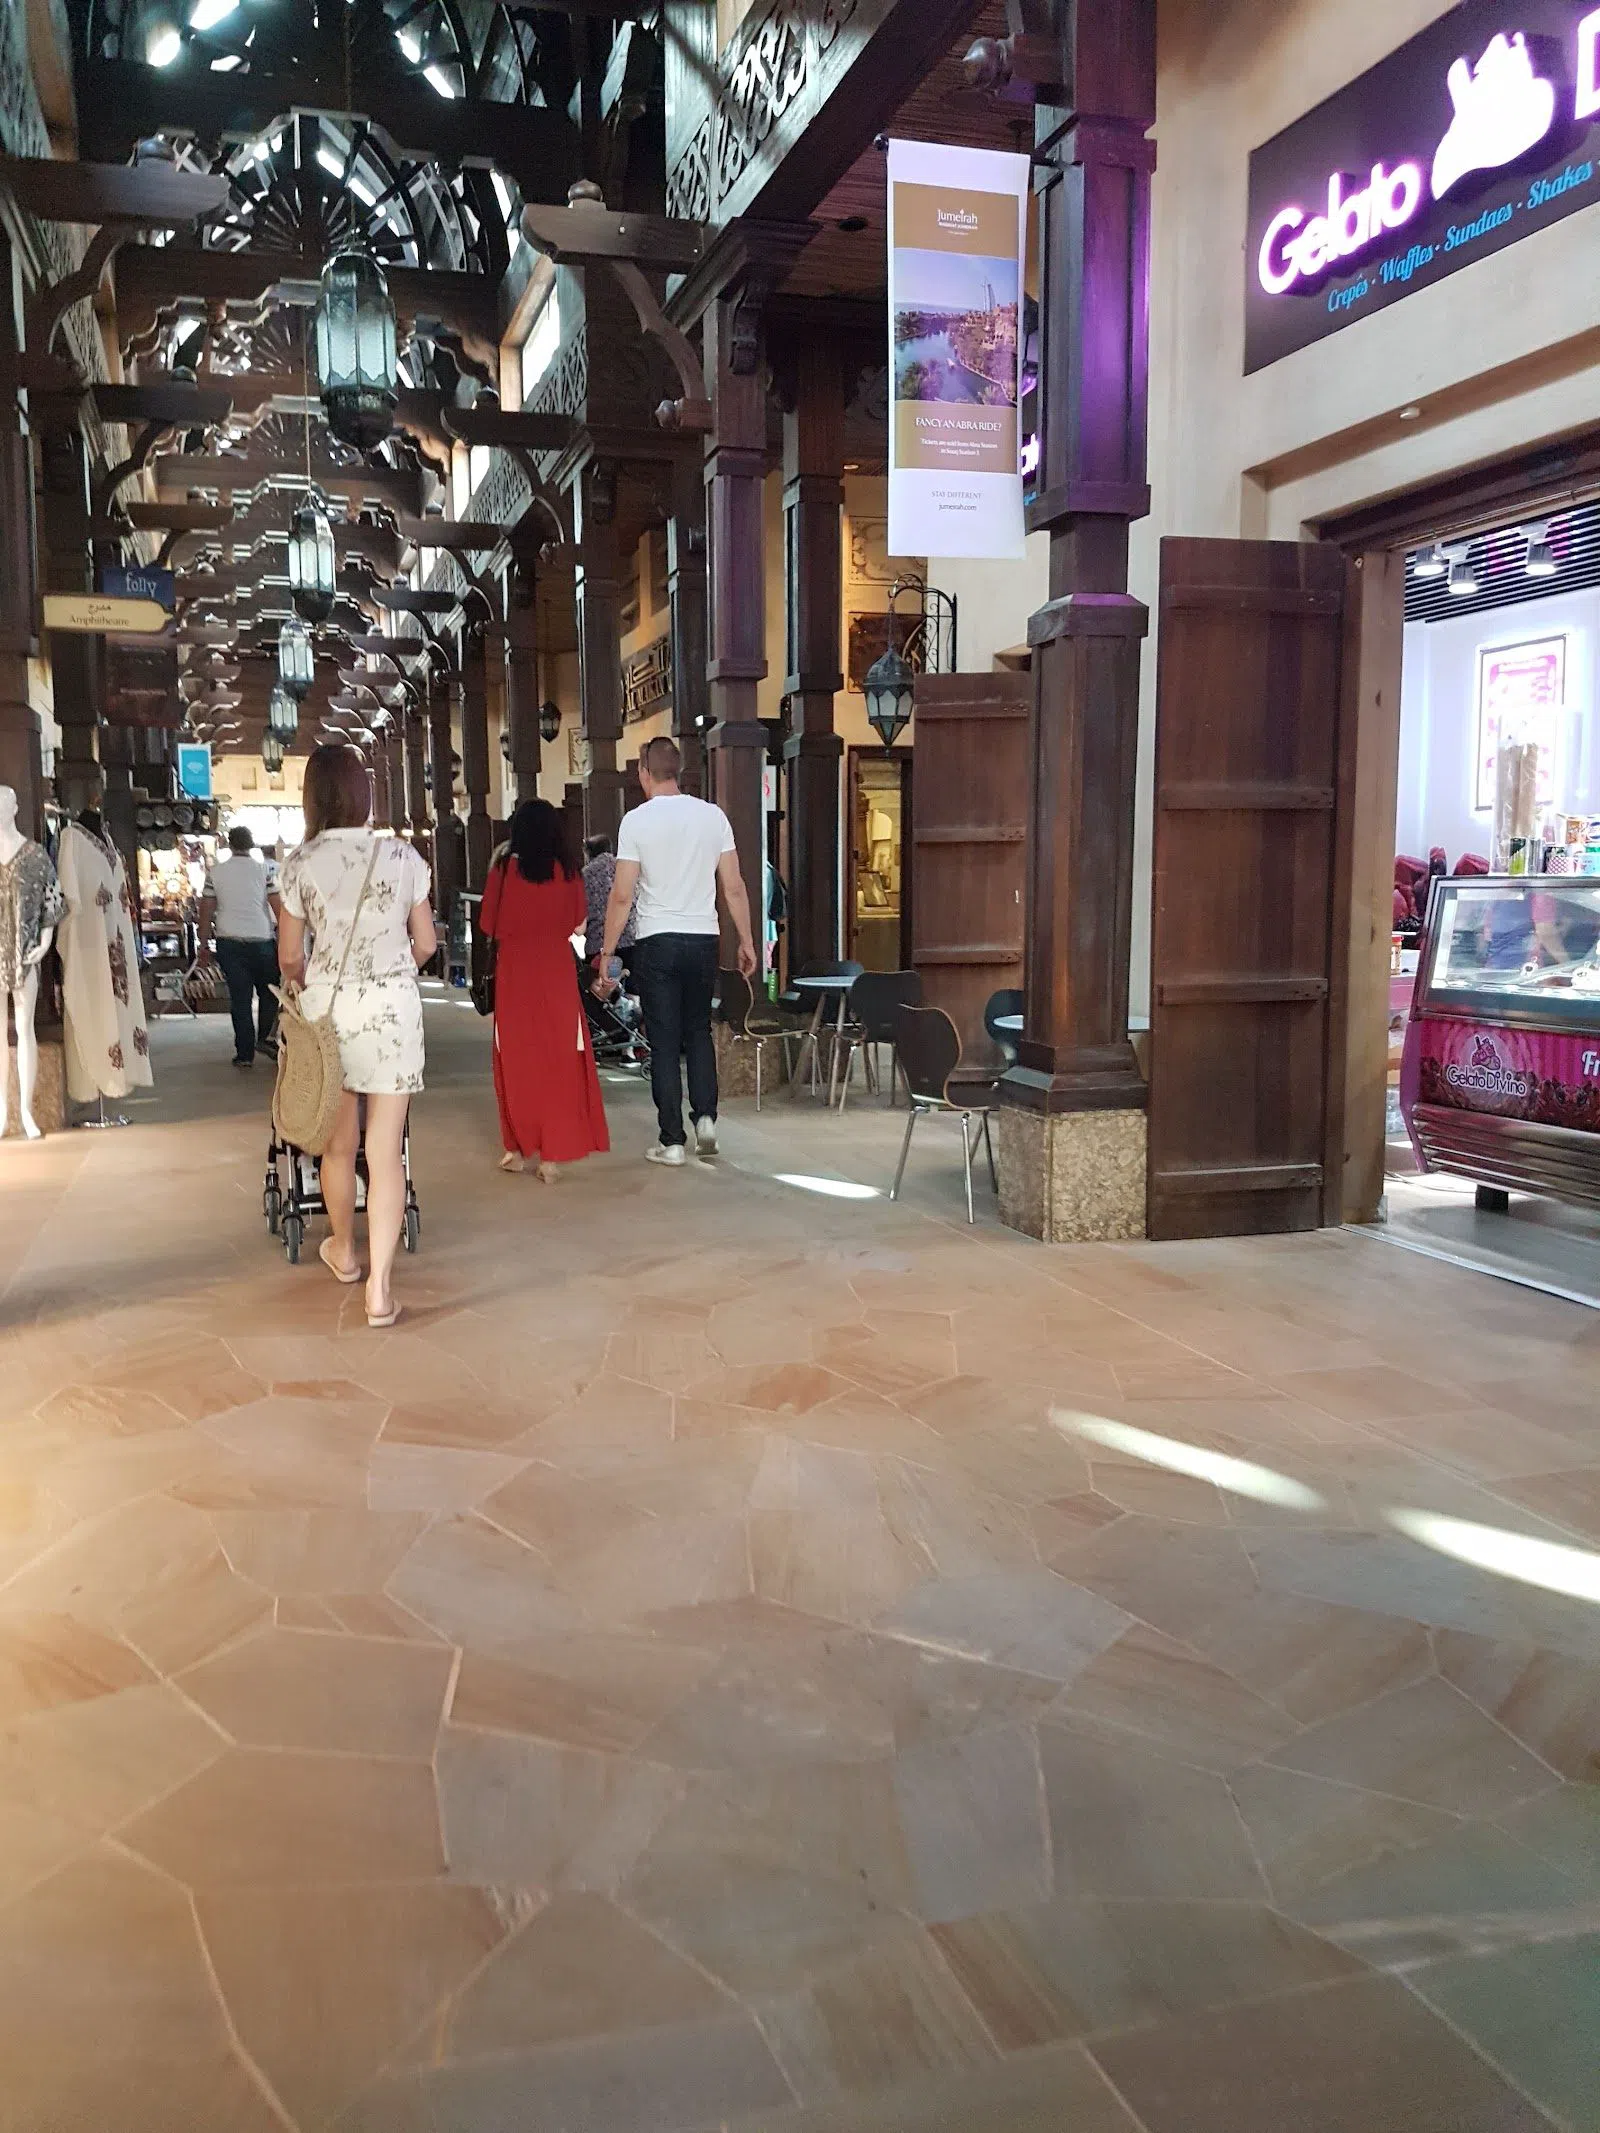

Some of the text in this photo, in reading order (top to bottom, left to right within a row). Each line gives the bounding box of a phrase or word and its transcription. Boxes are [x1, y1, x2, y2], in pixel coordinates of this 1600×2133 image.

[937, 208, 978, 225] Jumeirah
[1379, 242, 1434, 282] Waffles
[1444, 202, 1514, 252] Sundaes
[1526, 160, 1594, 210] Shakes
[1258, 162, 1420, 295] Gelato
[915, 417, 1002, 432] FANCY AN ABRA RIDE?
[947, 491, 982, 499] DIFFERENT
[125, 572, 157, 598] folly
